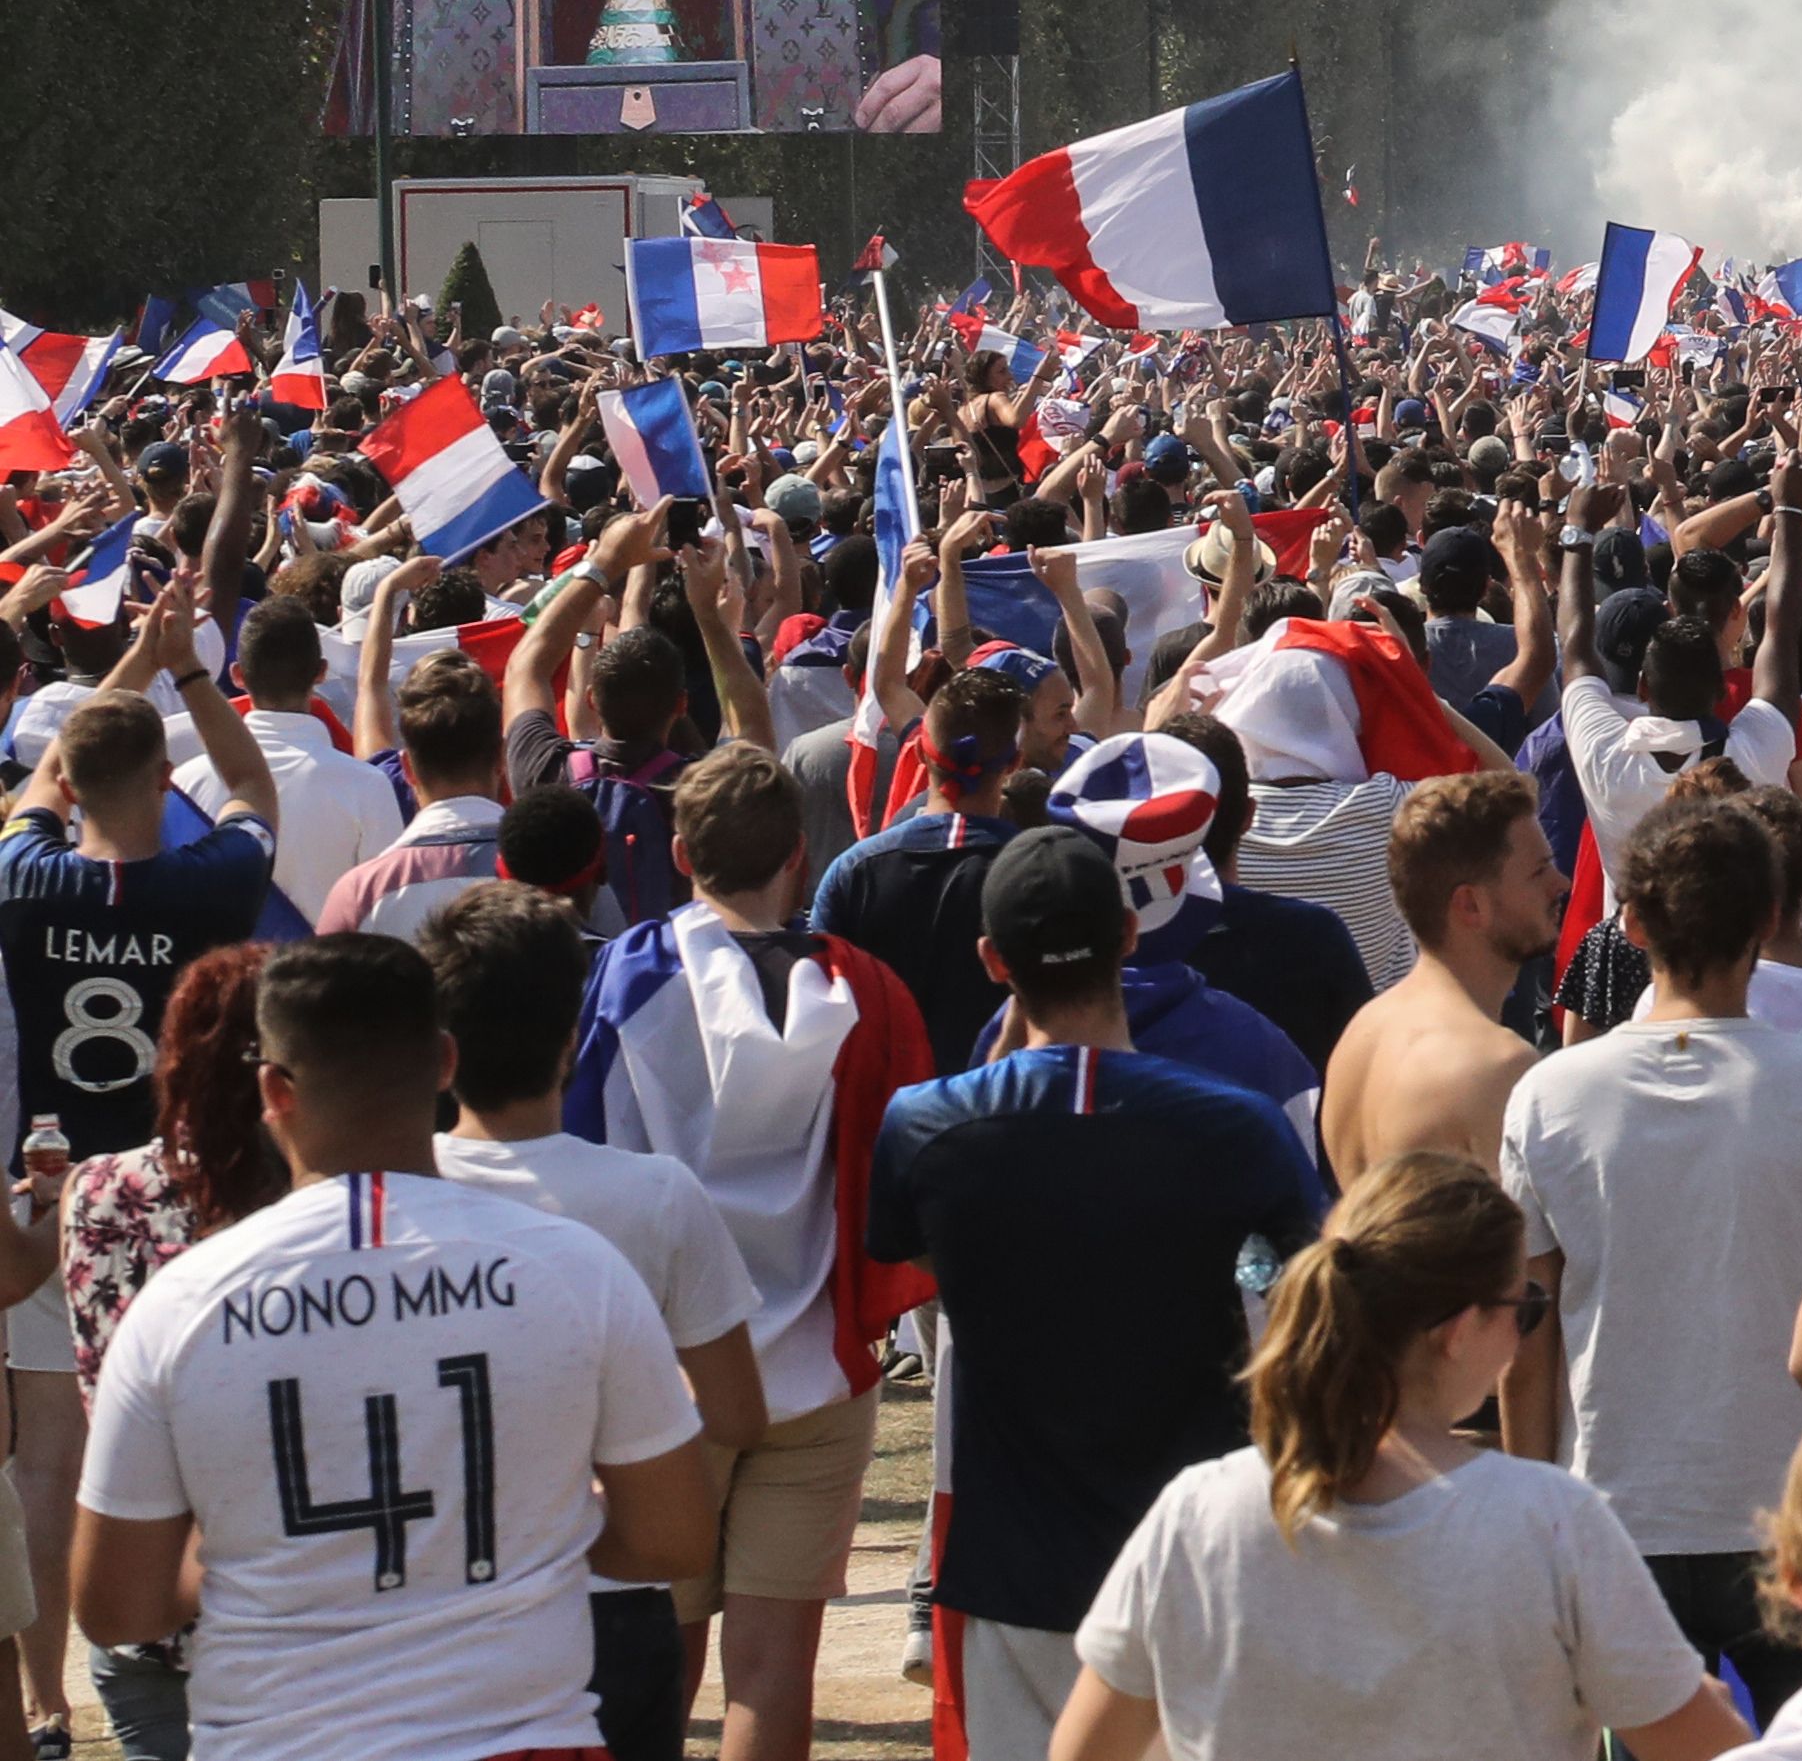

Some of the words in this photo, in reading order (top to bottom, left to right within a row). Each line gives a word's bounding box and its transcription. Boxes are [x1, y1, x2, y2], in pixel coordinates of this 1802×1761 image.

[45, 926, 174, 966] LEMAR
[52, 977, 158, 1093] 8
[222, 1273, 377, 1345] NONO
[392, 1256, 515, 1322] MMG
[267, 1352, 497, 1593] 41
